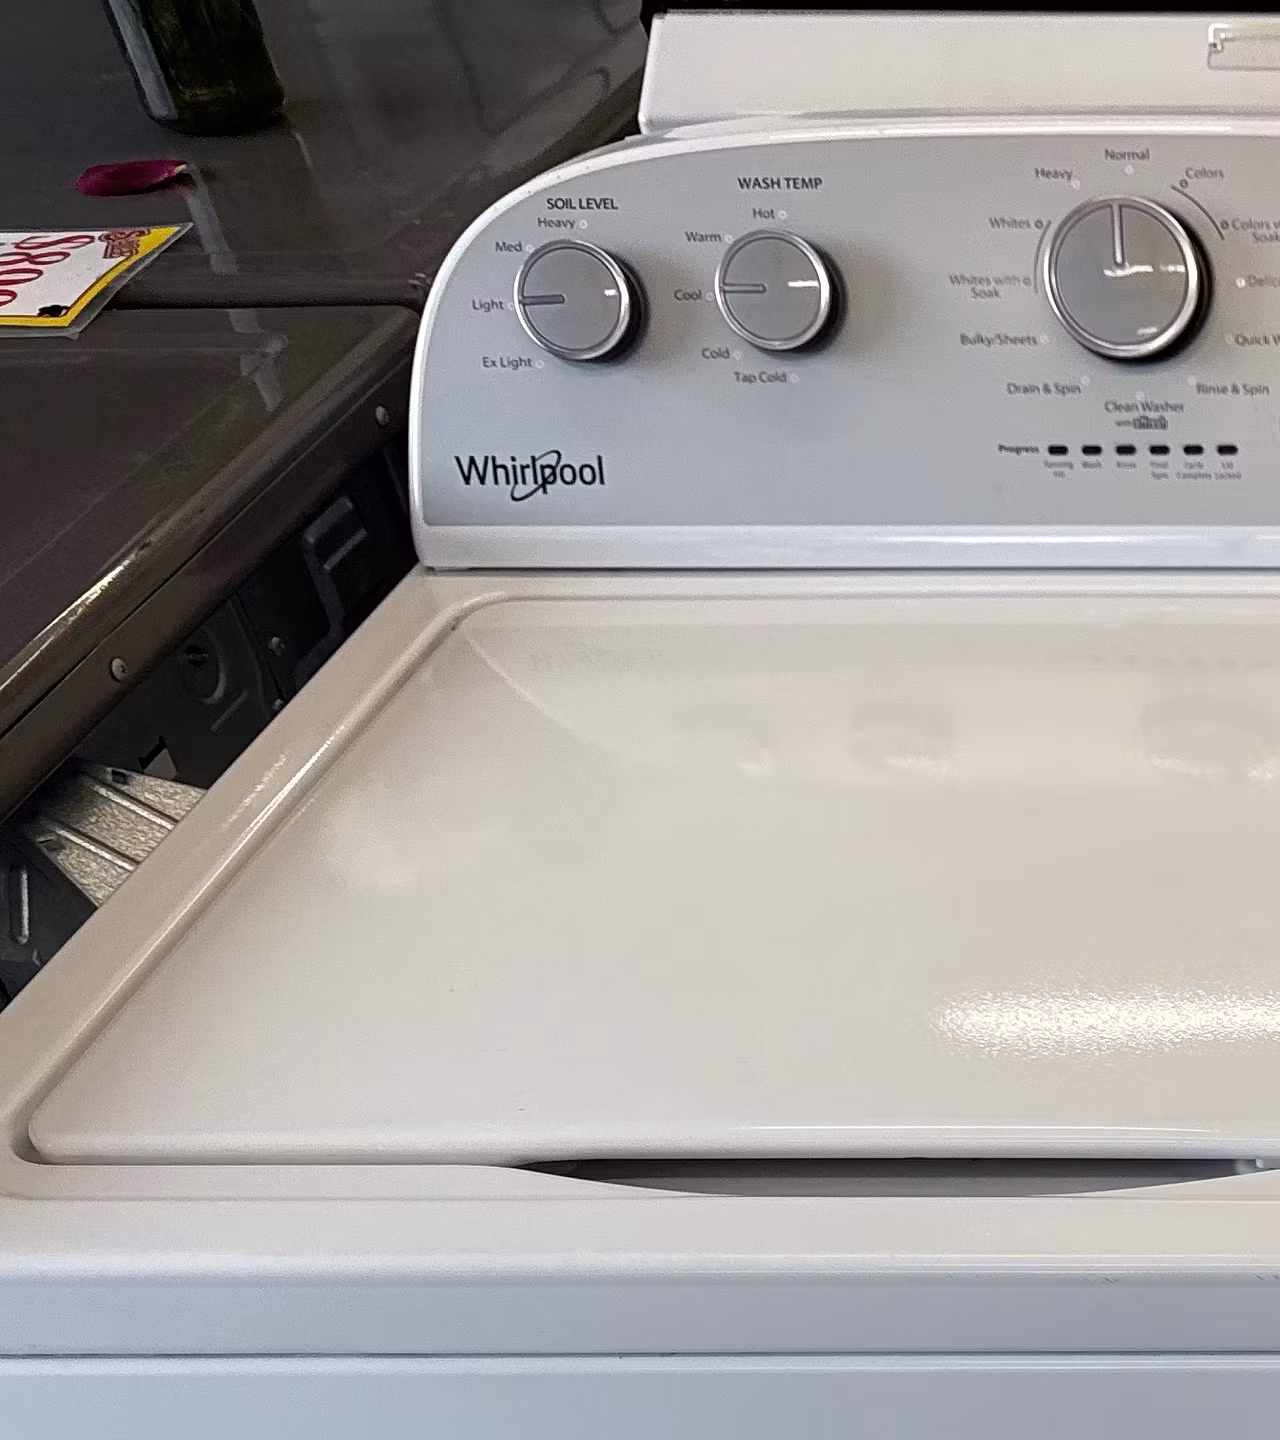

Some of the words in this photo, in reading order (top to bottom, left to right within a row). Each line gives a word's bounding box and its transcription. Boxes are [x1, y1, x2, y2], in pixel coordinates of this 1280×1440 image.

[1104, 149, 1150, 160] Normal
[1034, 168, 1073, 181] Heavy
[1185, 167, 1225, 179] Colors
[738, 177, 781, 190] WASH
[784, 178, 823, 190] TEMP
[546, 198, 578, 210] SOIL
[579, 199, 618, 210] LEVEL
[752, 208, 775, 219] Hot
[537, 217, 575, 231] Heavy
[988, 217, 1031, 229] Whites
[1231, 218, 1271, 230] Colors
[685, 232, 721, 242] Warm
[495, 241, 523, 253] Med
[674, 289, 703, 301] Cool
[472, 298, 504, 313] Light
[1234, 334, 1270, 346] Quick
[702, 347, 730, 360] Cold
[482, 356, 498, 368] Ex
[500, 356, 533, 370] Light
[734, 372, 756, 385] Tap
[757, 371, 787, 383] Cold
[1006, 383, 1040, 395] Drain
[1043, 383, 1052, 395] &
[1054, 383, 1082, 397] Spin
[1196, 384, 1229, 395] Rinse
[1231, 384, 1240, 395] &
[1242, 384, 1270, 398] Spin
[1104, 401, 1139, 413] Clean
[1141, 401, 1184, 413] Washer
[454, 451, 605, 498] Whirlpool
